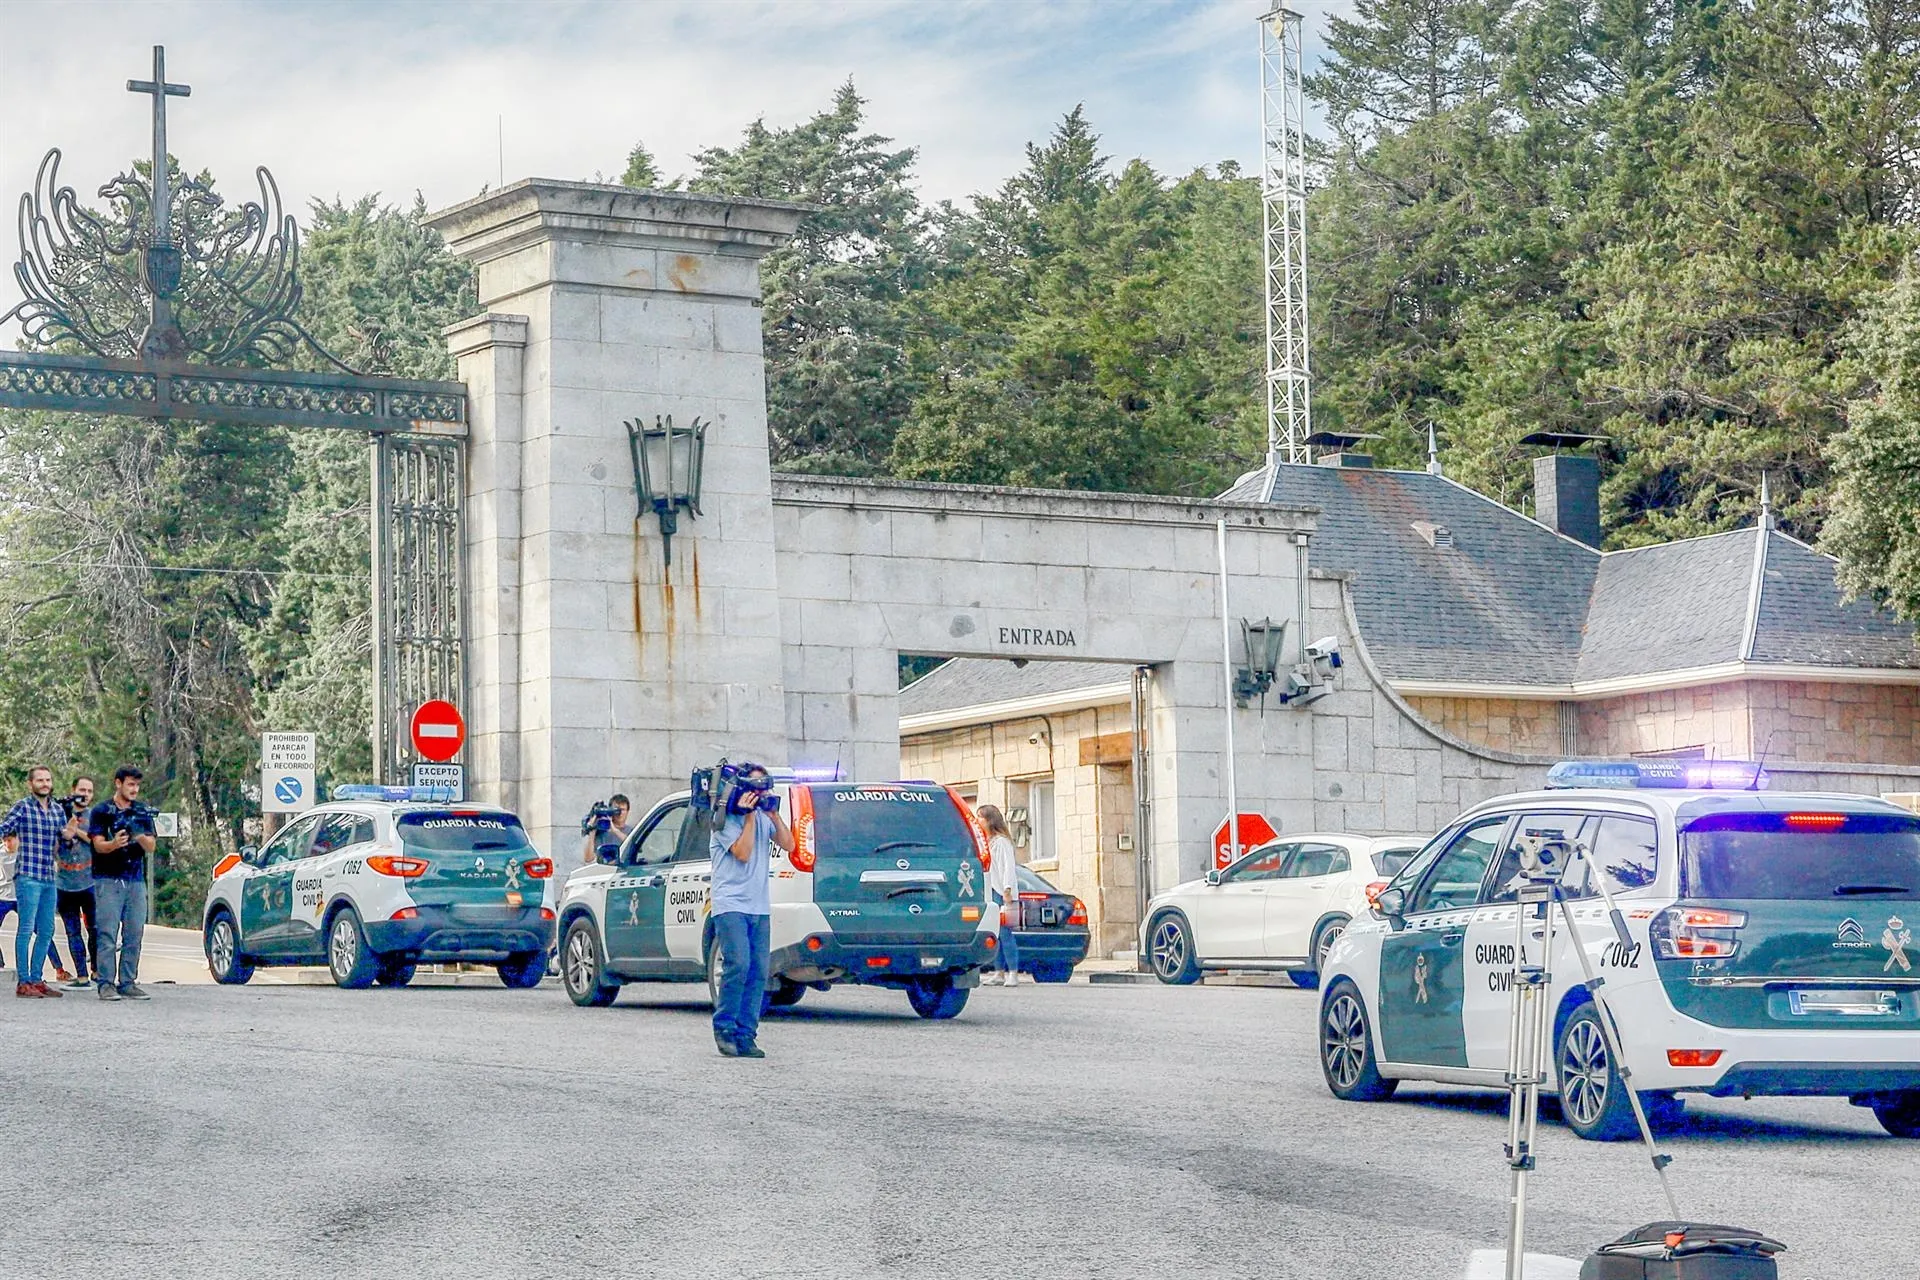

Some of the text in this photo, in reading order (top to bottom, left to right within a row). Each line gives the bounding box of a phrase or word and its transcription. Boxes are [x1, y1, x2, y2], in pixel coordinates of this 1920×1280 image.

[999, 627, 1077, 646] ENTRADA
[418, 767, 459, 776] EXCEPTO
[419, 779, 459, 787] SERVICIO
[834, 791, 935, 803] GUARDIA CIVIL
[423, 819, 506, 831] GUARDIA CIVIL
[295, 878, 322, 892] GUARDIA
[302, 894, 316, 907] CIVIL
[670, 890, 703, 905] GUARDIA
[677, 909, 696, 923] CIVIL
[829, 909, 860, 917] X-TRAIL
[1475, 944, 1527, 965] GUARDA
[1488, 971, 1515, 992] CIVI
